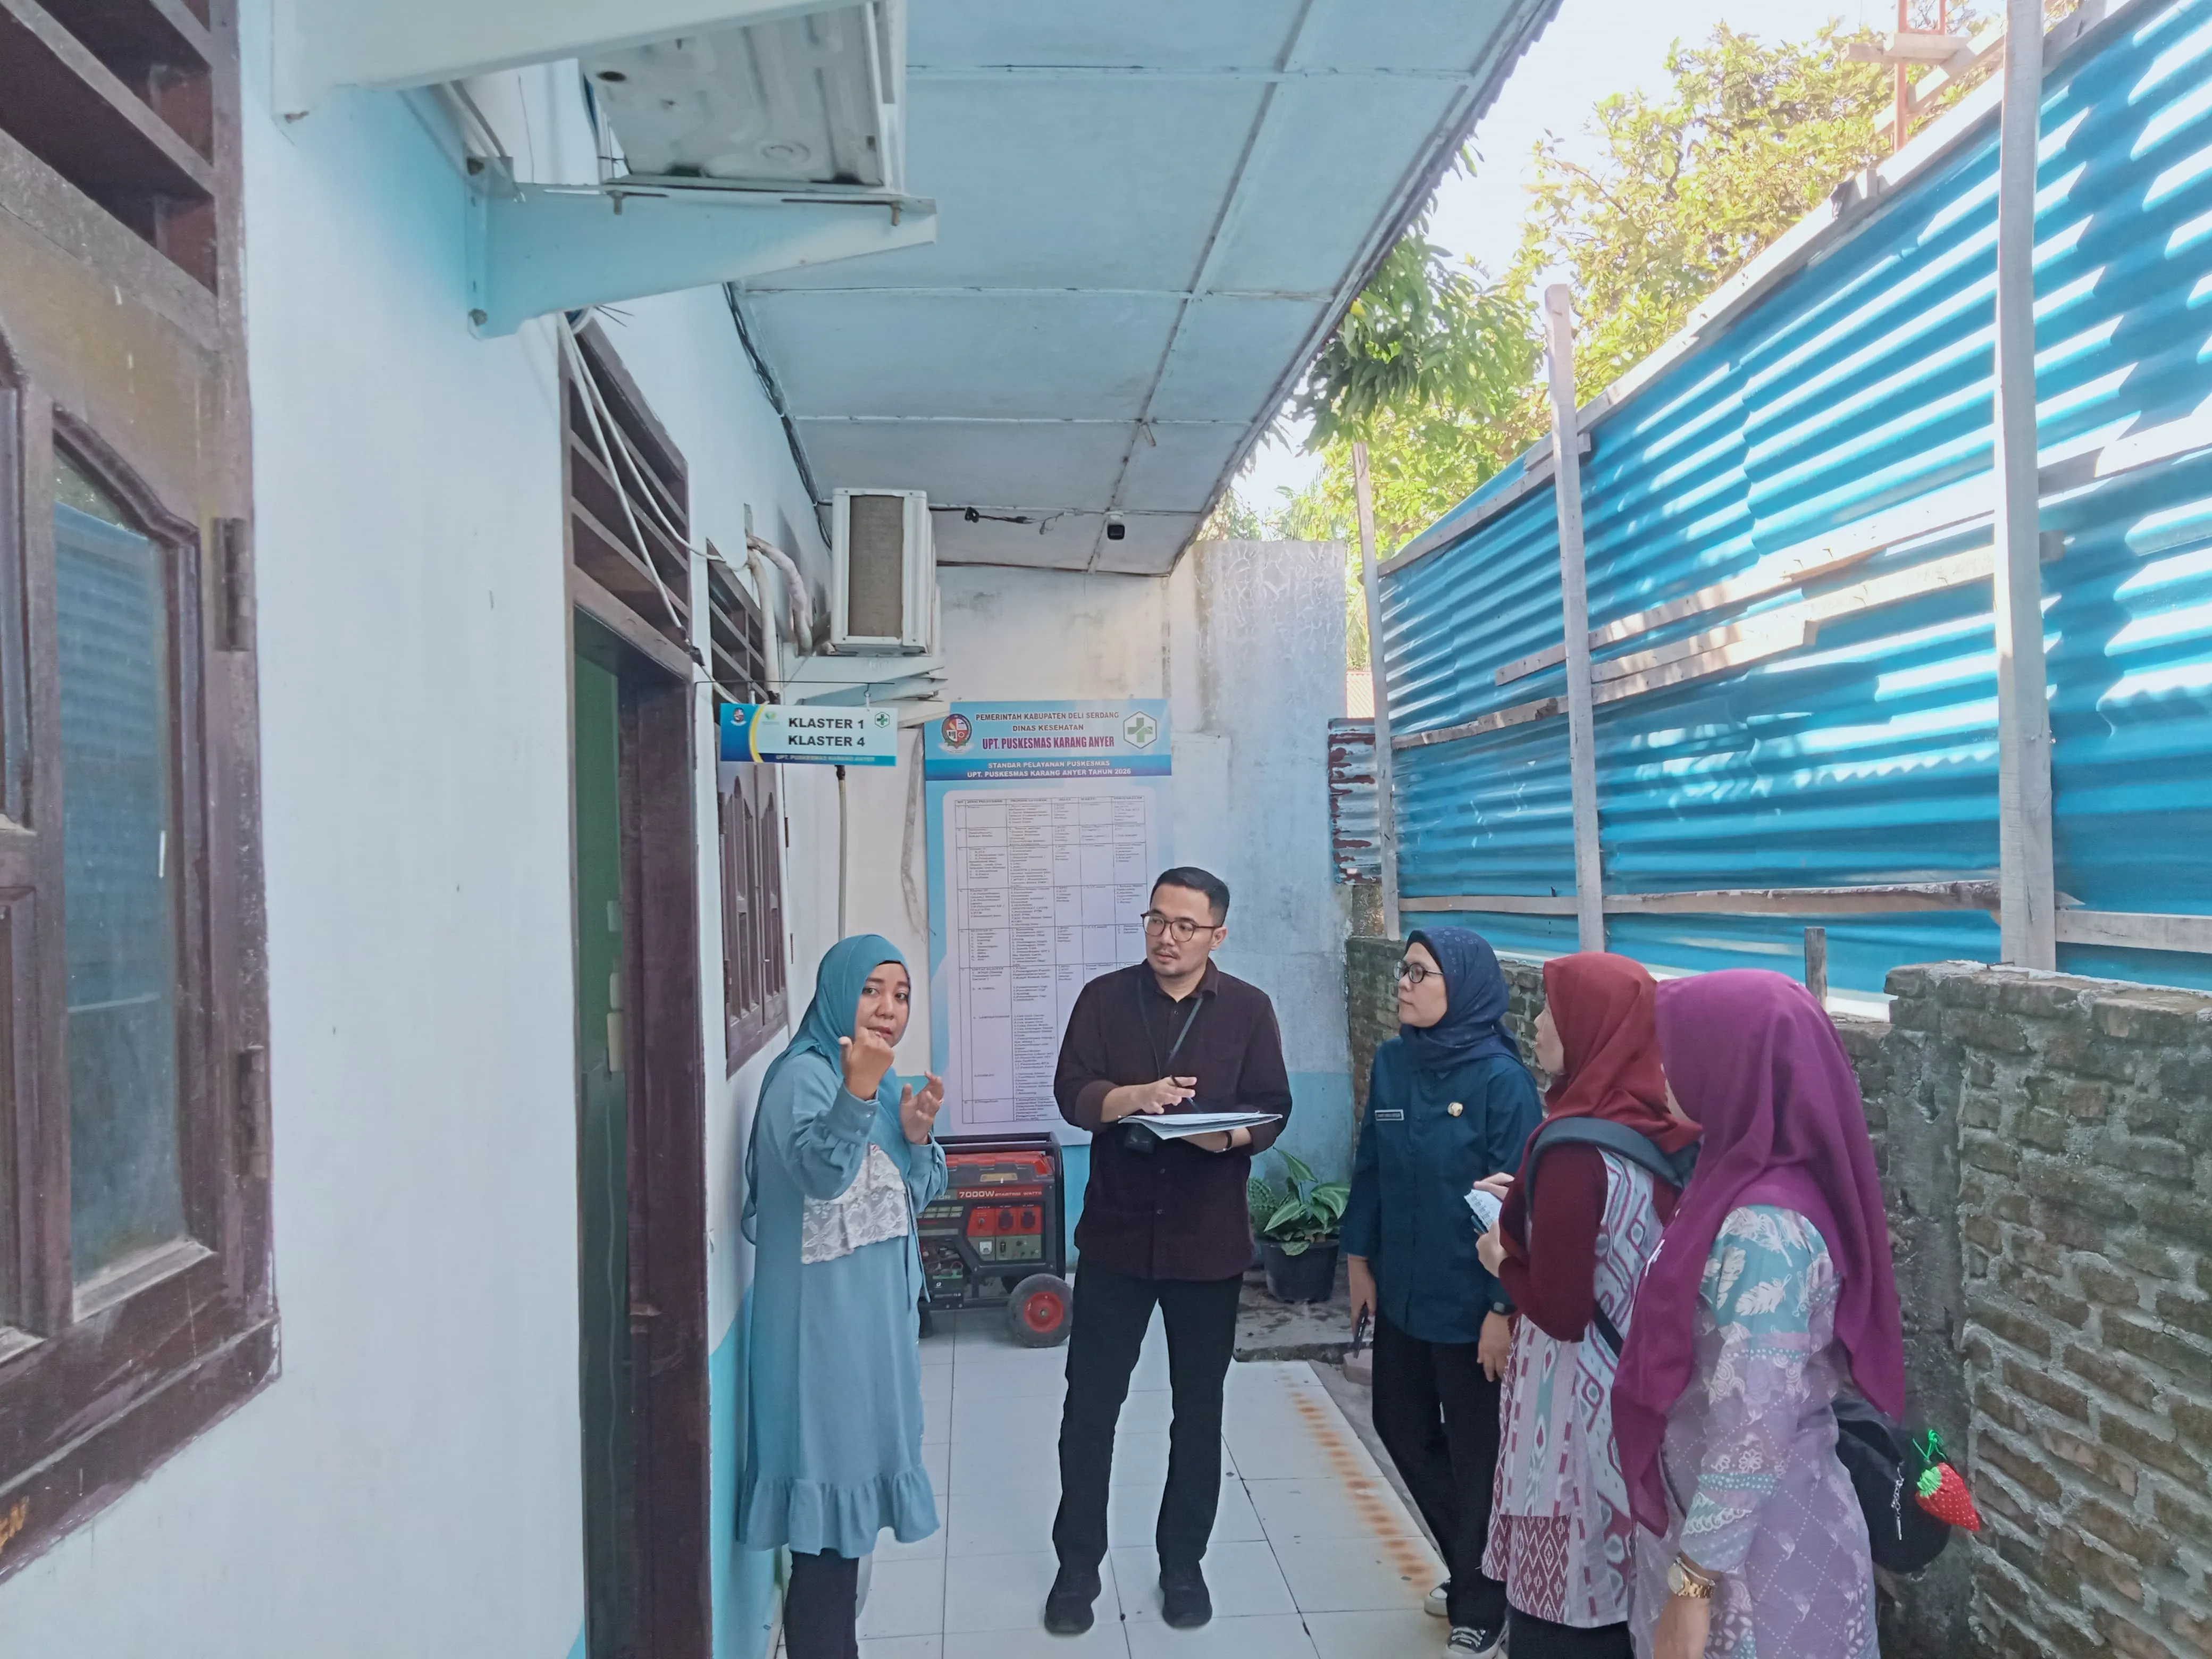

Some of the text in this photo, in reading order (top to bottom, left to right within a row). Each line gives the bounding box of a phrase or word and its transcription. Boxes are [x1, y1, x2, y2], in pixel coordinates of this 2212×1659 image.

[789, 718, 864, 729] KLASTER 1
[788, 735, 865, 747] KLASTER 4
[982, 736, 1115, 750] UPT. PUSKESMAS KARANG ANYER
